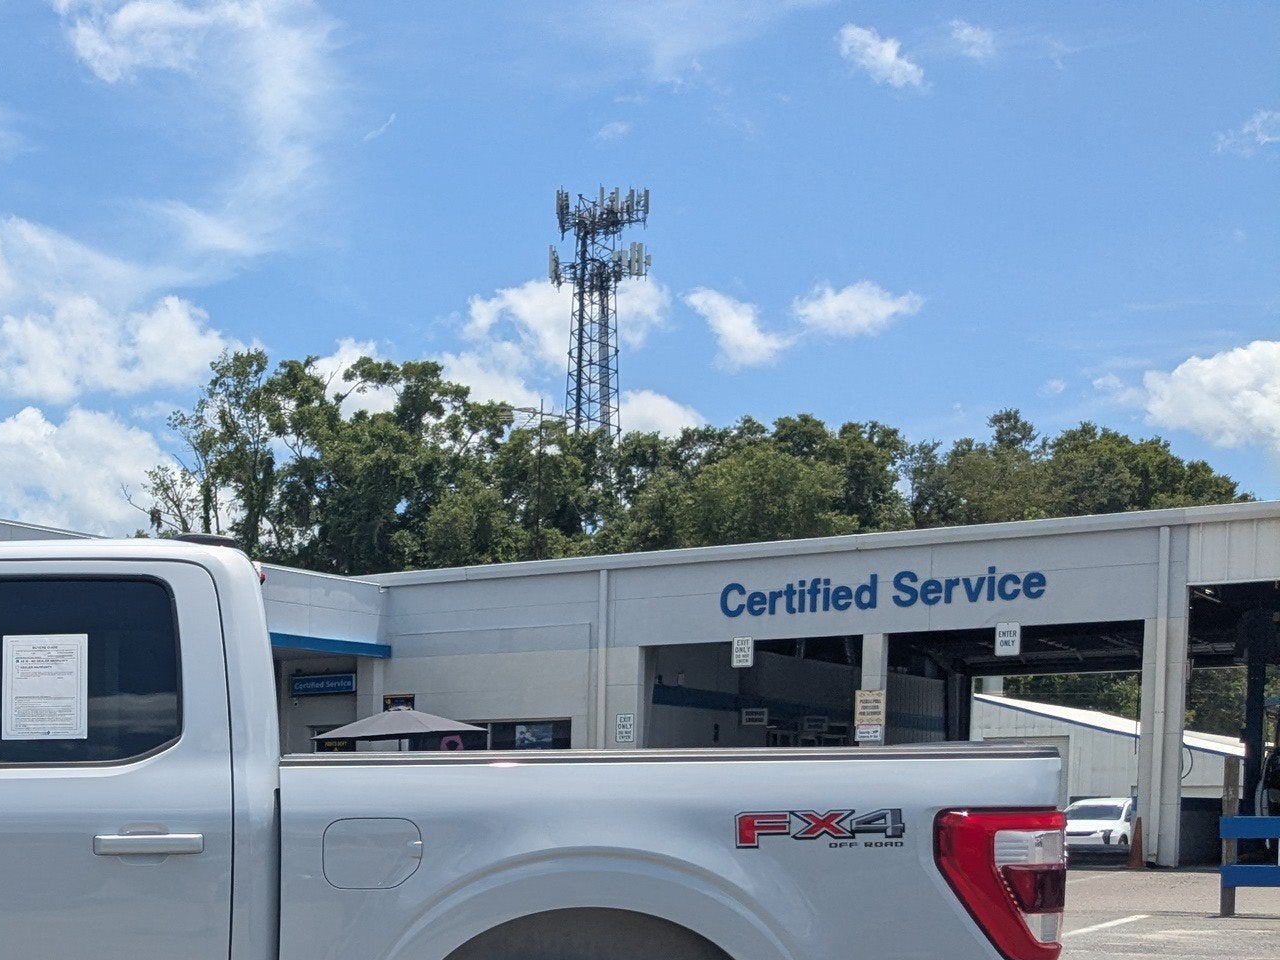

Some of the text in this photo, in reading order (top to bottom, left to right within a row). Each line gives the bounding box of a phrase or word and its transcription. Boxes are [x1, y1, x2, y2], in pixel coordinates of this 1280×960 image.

[720, 566, 1046, 618] Certified Service
[998, 629, 1017, 638] ENTER
[999, 639, 1016, 647] ONLY
[735, 646, 751, 654] ONLY
[294, 679, 351, 690] Certified Service
[735, 808, 905, 849] FX4
